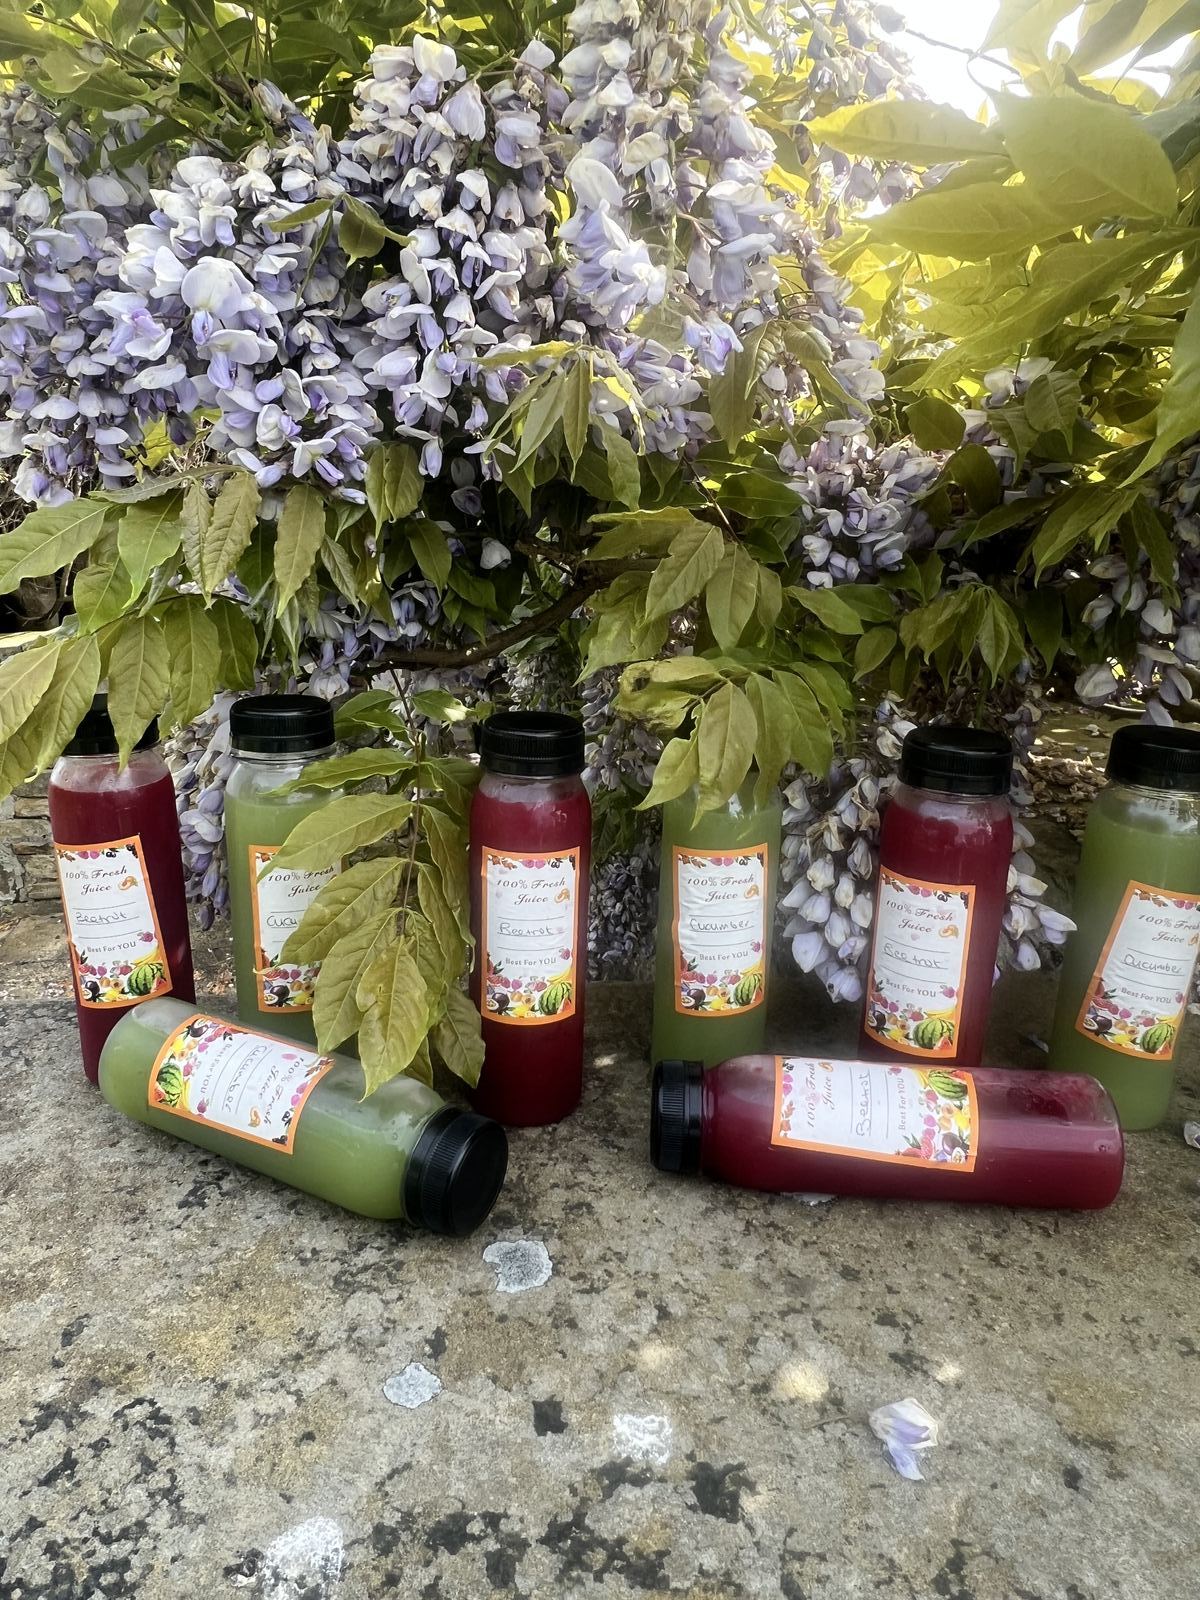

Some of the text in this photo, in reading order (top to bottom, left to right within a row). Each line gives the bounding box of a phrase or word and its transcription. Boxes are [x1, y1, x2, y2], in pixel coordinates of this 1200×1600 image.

[65, 865, 127, 880] 100% Fresh
[268, 865, 334, 881] 100% Fresh
[496, 877, 566, 889] 100% Fresh
[688, 874, 754, 887] 100% Fresh
[81, 884, 112, 895] Juice
[287, 884, 320, 897] Juice
[704, 890, 738, 902] Juice
[514, 894, 548, 905] Juice
[886, 899, 953, 921] 100% Fresh
[266, 915, 298, 927] Cucu
[689, 918, 749, 931] Cucumber
[898, 919, 933, 933] Juice
[1138, 914, 1200, 930] 100% Fres
[1152, 930, 1185, 943] Juice
[103, 944, 116, 952] For
[117, 941, 137, 950] YOU
[505, 957, 522, 965] Best
[539, 957, 557, 965] YOU
[731, 950, 749, 958] YOU
[885, 978, 937, 998] Best For YOU
[1121, 987, 1172, 1004] Best For YOU
[200, 1043, 232, 1094] Best For YOU
[258, 1065, 280, 1100] Juice
[264, 1057, 304, 1126] 100% Fresh
[805, 1062, 816, 1128] 100% Fresh
[821, 1077, 835, 1110] Juice
[897, 1077, 907, 1130] Best For YOU
